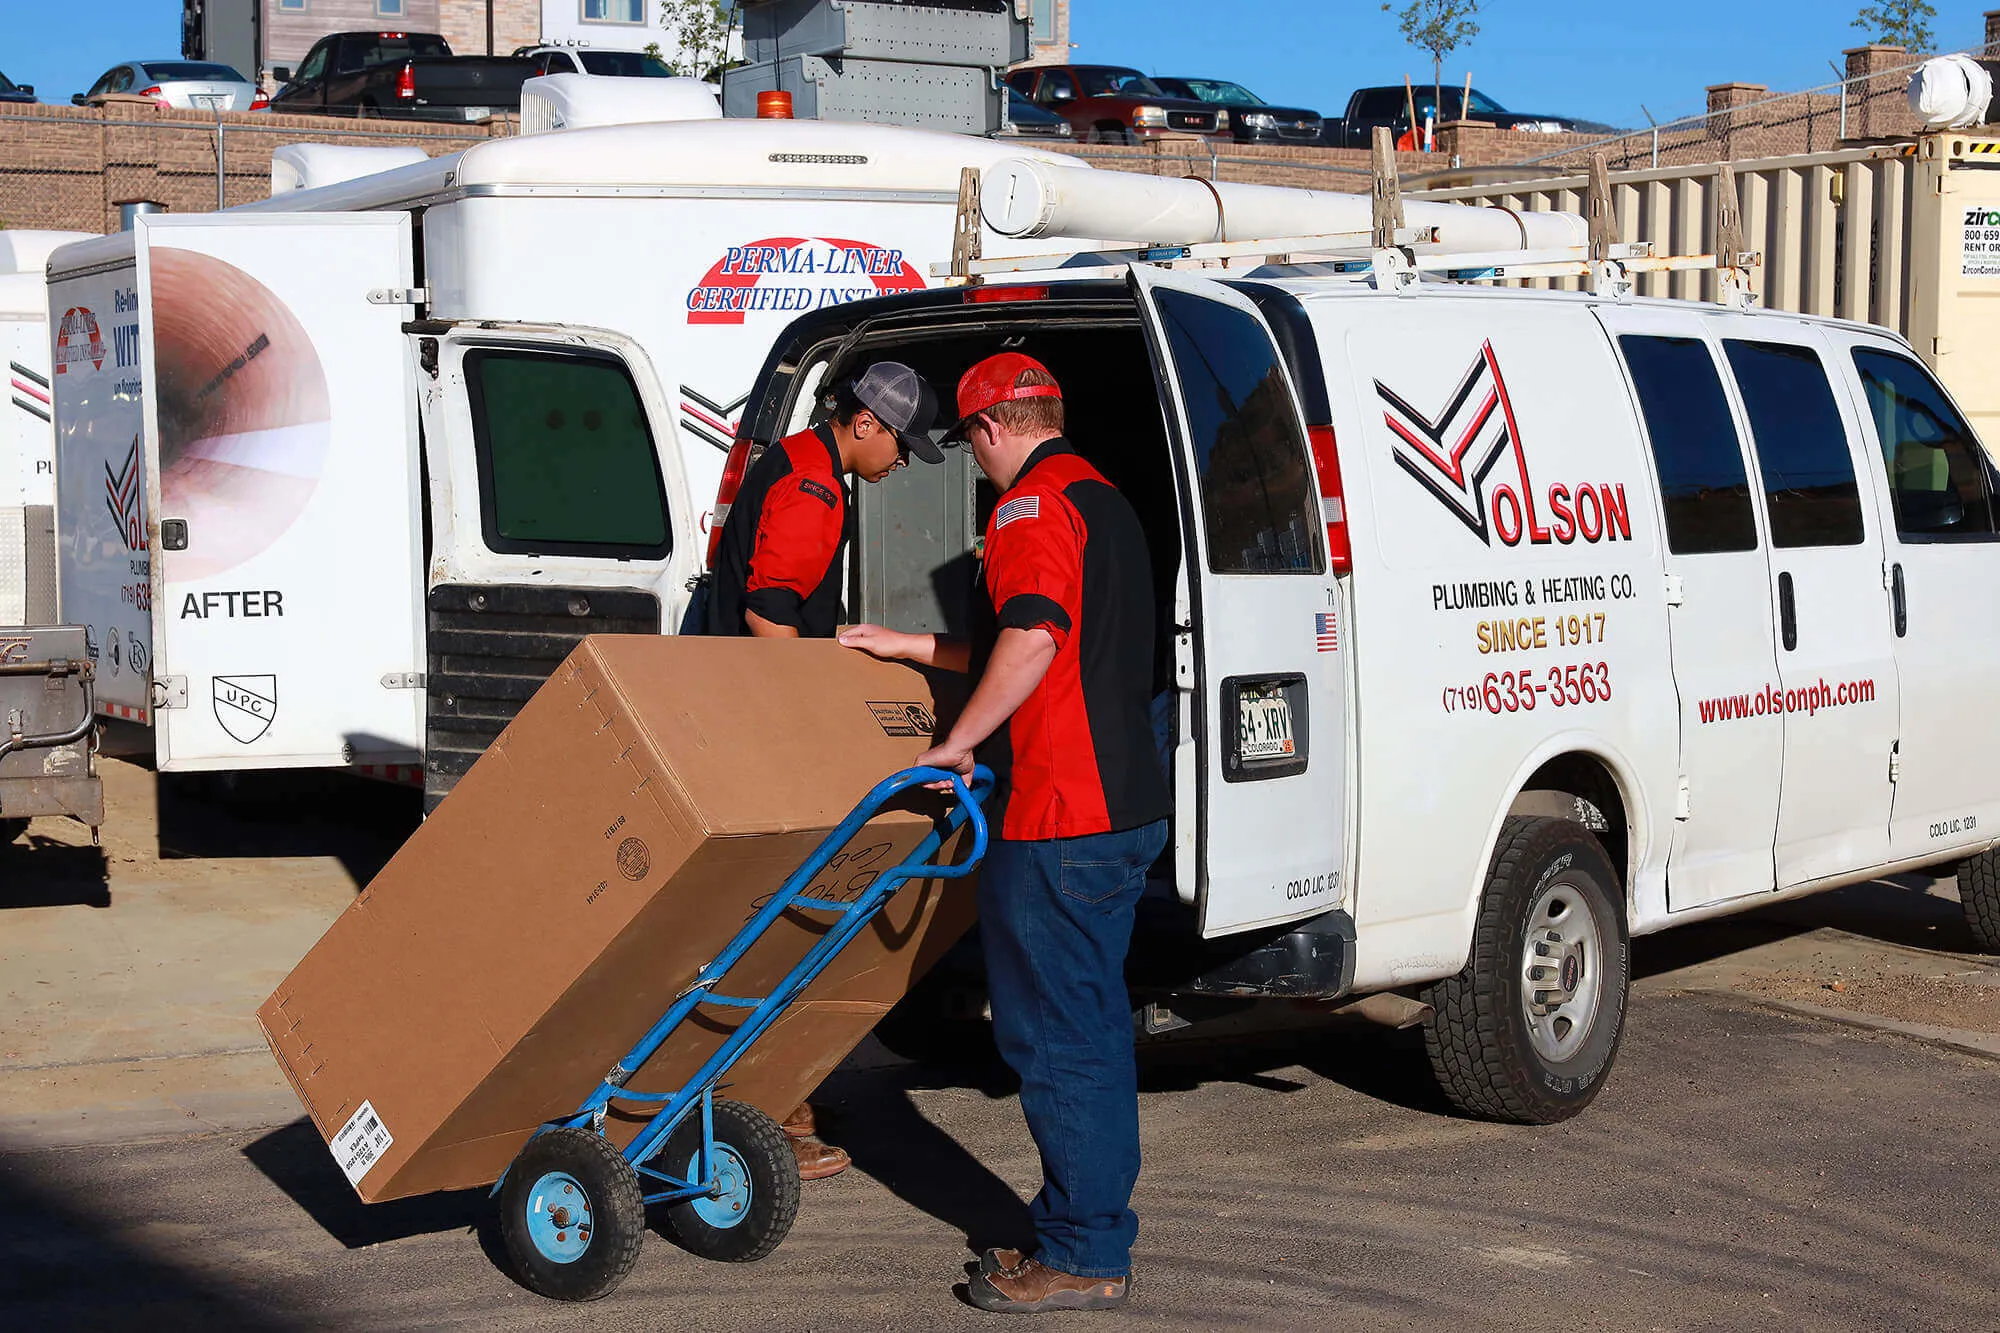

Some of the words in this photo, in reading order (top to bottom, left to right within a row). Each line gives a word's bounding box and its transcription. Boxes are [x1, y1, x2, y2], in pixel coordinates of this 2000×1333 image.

[1964, 207, 2000, 226] zirc
[1964, 230, 1981, 240] 800
[1984, 230, 1999, 240] 659
[1964, 243, 1986, 252] RENT
[721, 247, 903, 275] PERMA-LINER
[686, 287, 812, 311] CERTIFIED
[1491, 482, 1632, 547] OLSON
[1432, 580, 1518, 611] PLUMBING
[1525, 579, 1537, 606] &
[1542, 575, 1606, 603] HEATING
[1610, 573, 1637, 600] CO.
[181, 591, 283, 619] AFTER
[1476, 616, 1547, 655] SINCE
[1555, 612, 1606, 647] 1917
[227, 689, 262, 713] UPC
[1698, 678, 1876, 724] www.olsonph.com
[1247, 741, 1279, 754] COLORADO
[1929, 821, 1948, 838] COLO
[1964, 815, 1977, 830] 1231
[1286, 879, 1311, 900] COLO
